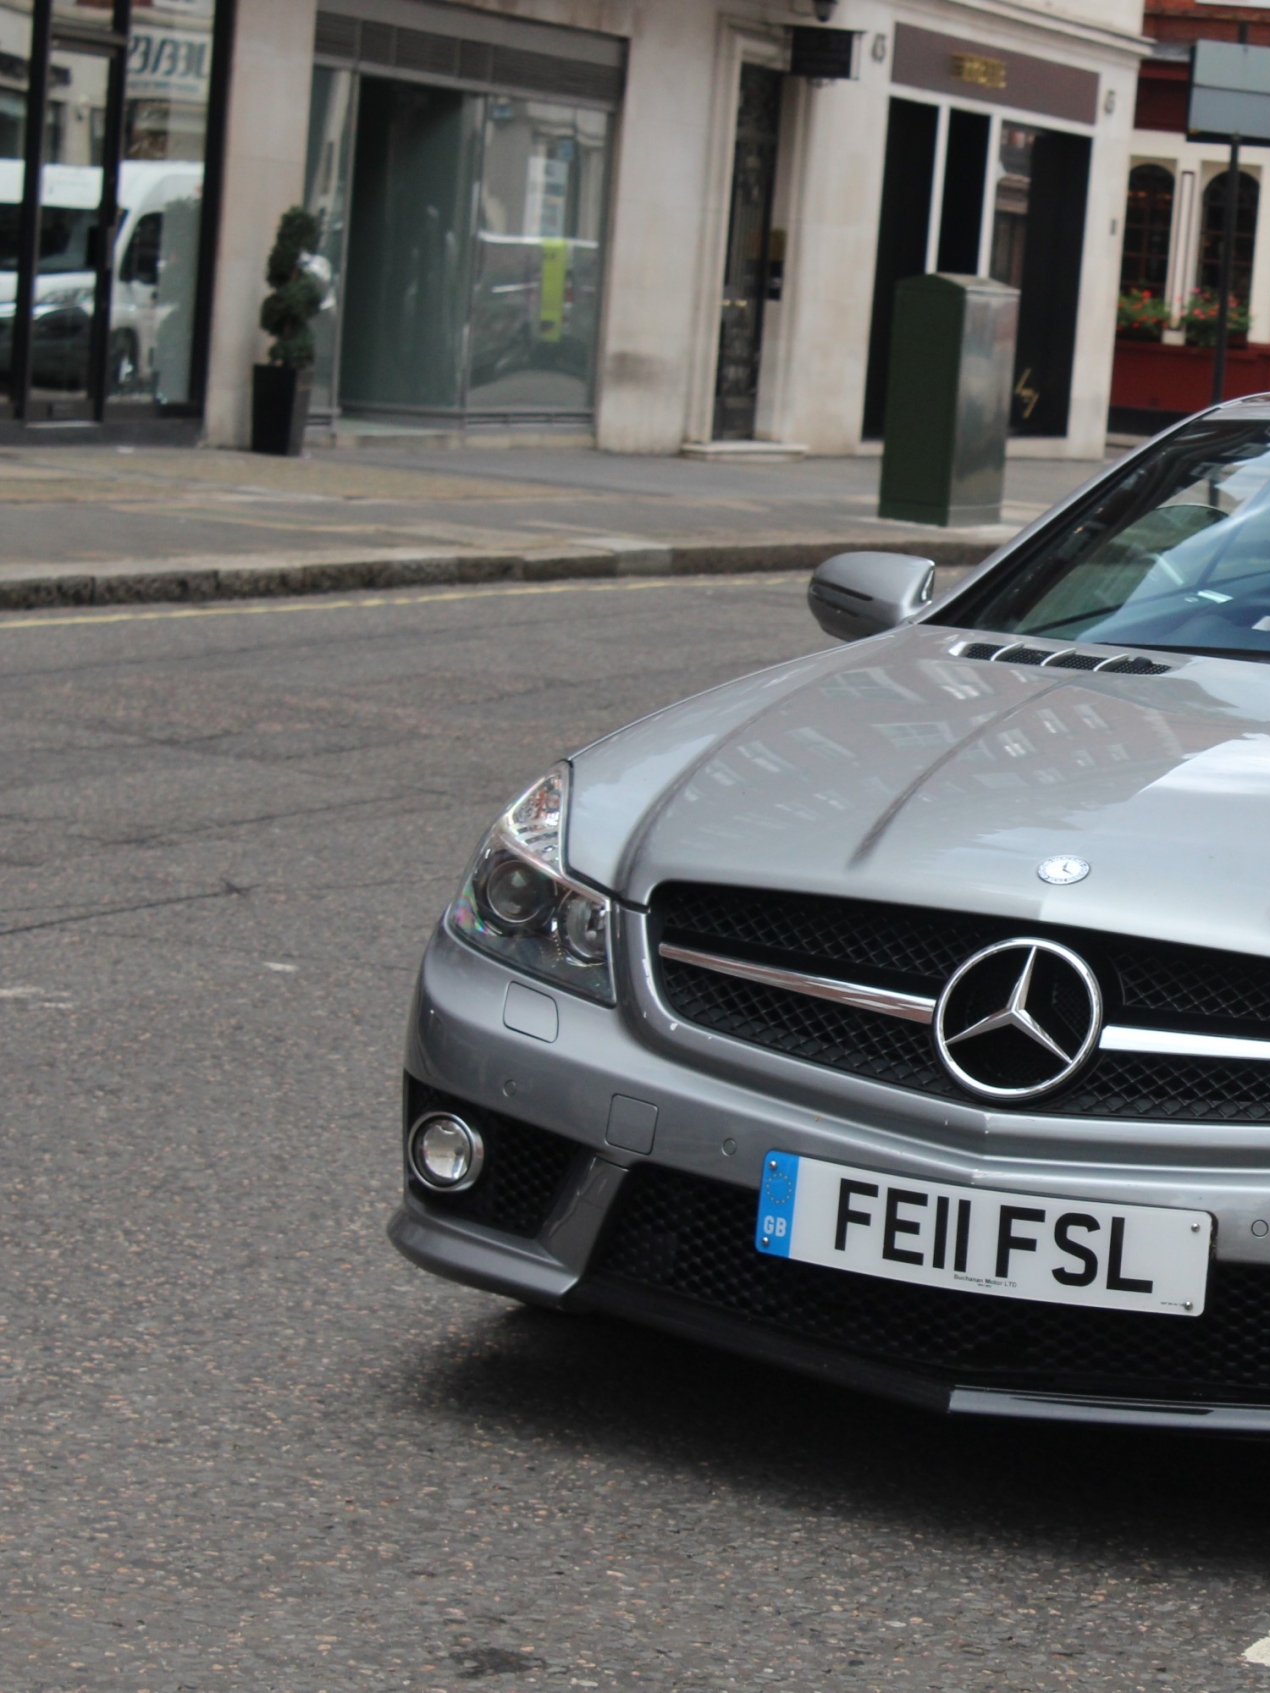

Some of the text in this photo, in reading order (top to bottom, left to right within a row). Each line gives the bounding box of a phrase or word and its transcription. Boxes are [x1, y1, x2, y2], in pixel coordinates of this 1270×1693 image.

[763, 1216, 787, 1237] GB
[995, 1204, 1154, 1293] FSL
[954, 1274, 984, 1283] Buchanan
